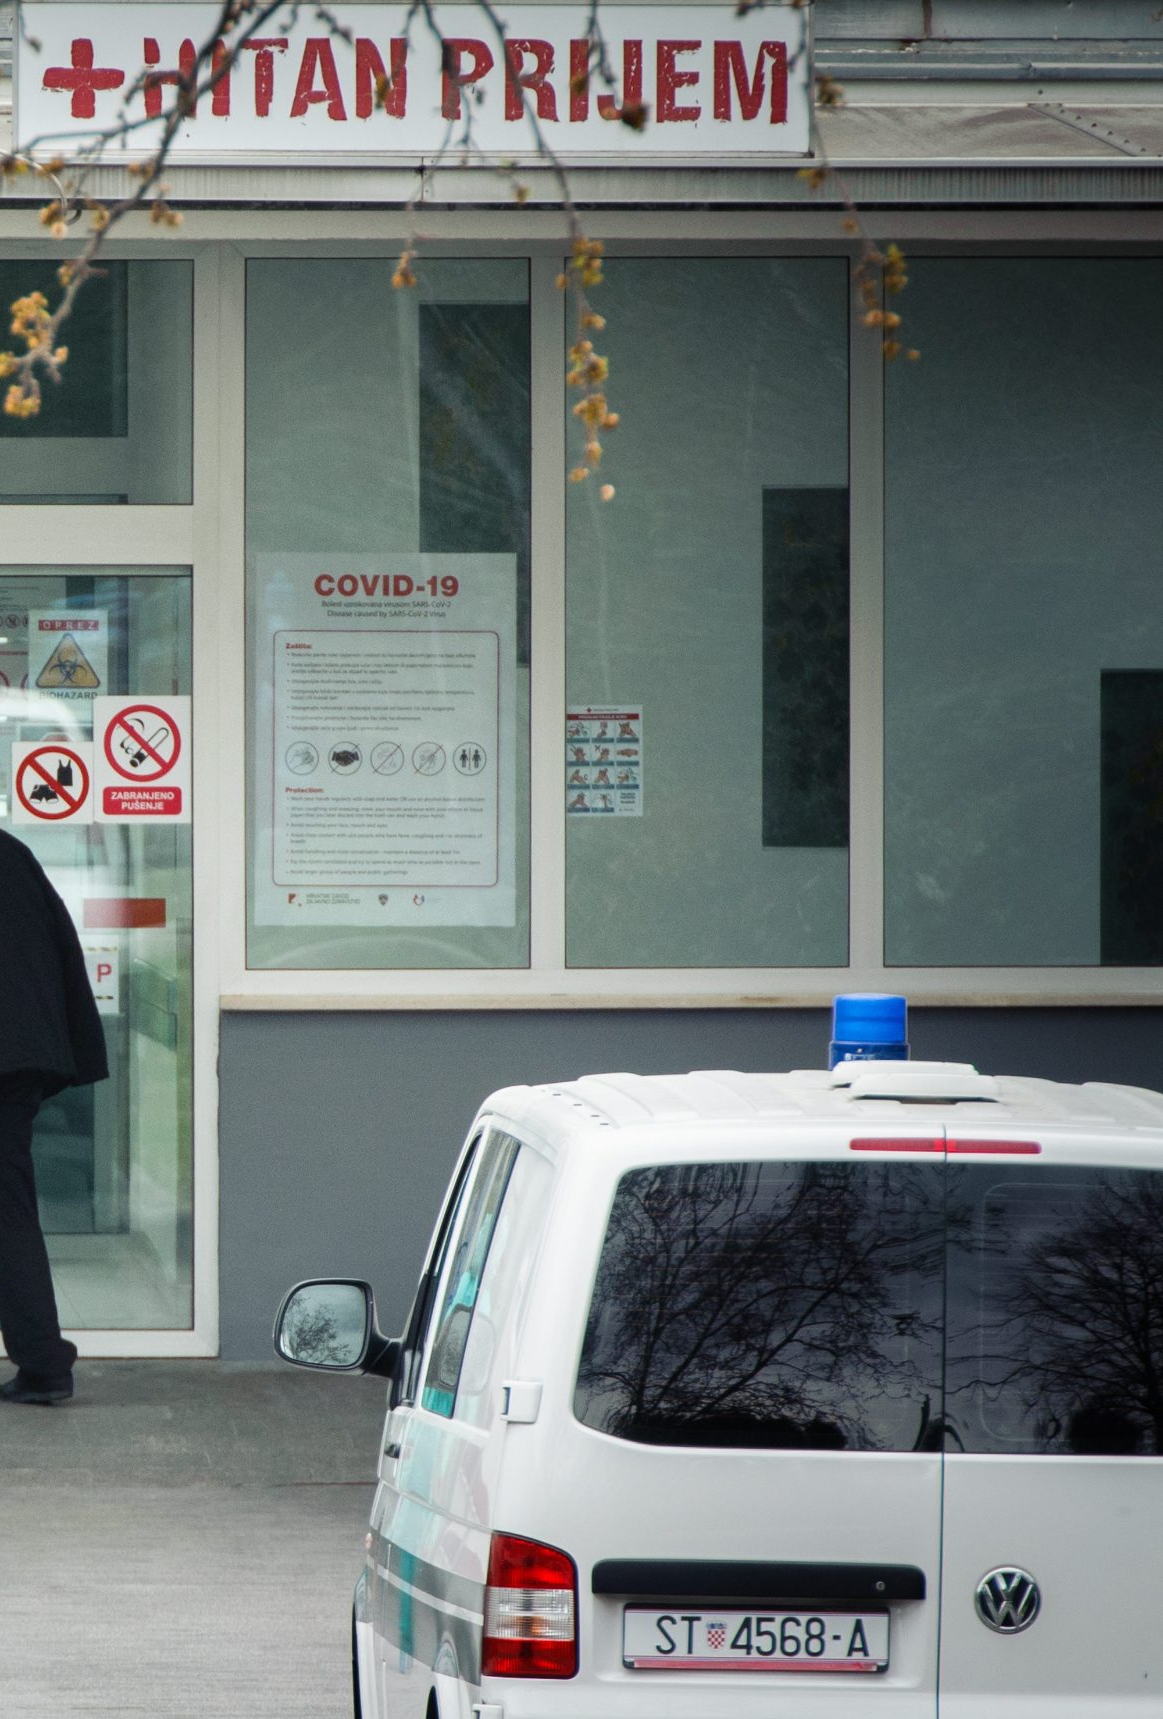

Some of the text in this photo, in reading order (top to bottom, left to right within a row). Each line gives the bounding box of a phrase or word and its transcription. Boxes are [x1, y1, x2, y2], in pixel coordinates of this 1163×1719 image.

[142, 36, 788, 125] HITAN PRIJEM
[314, 573, 459, 597] COVID-19
[43, 621, 95, 630] OPREZ
[39, 691, 98, 700] BIOHAZARD
[110, 791, 175, 800] ZABRANJENO
[121, 800, 165, 810] PUŠENJE
[655, 1614, 870, 1657] ST 4568-A
